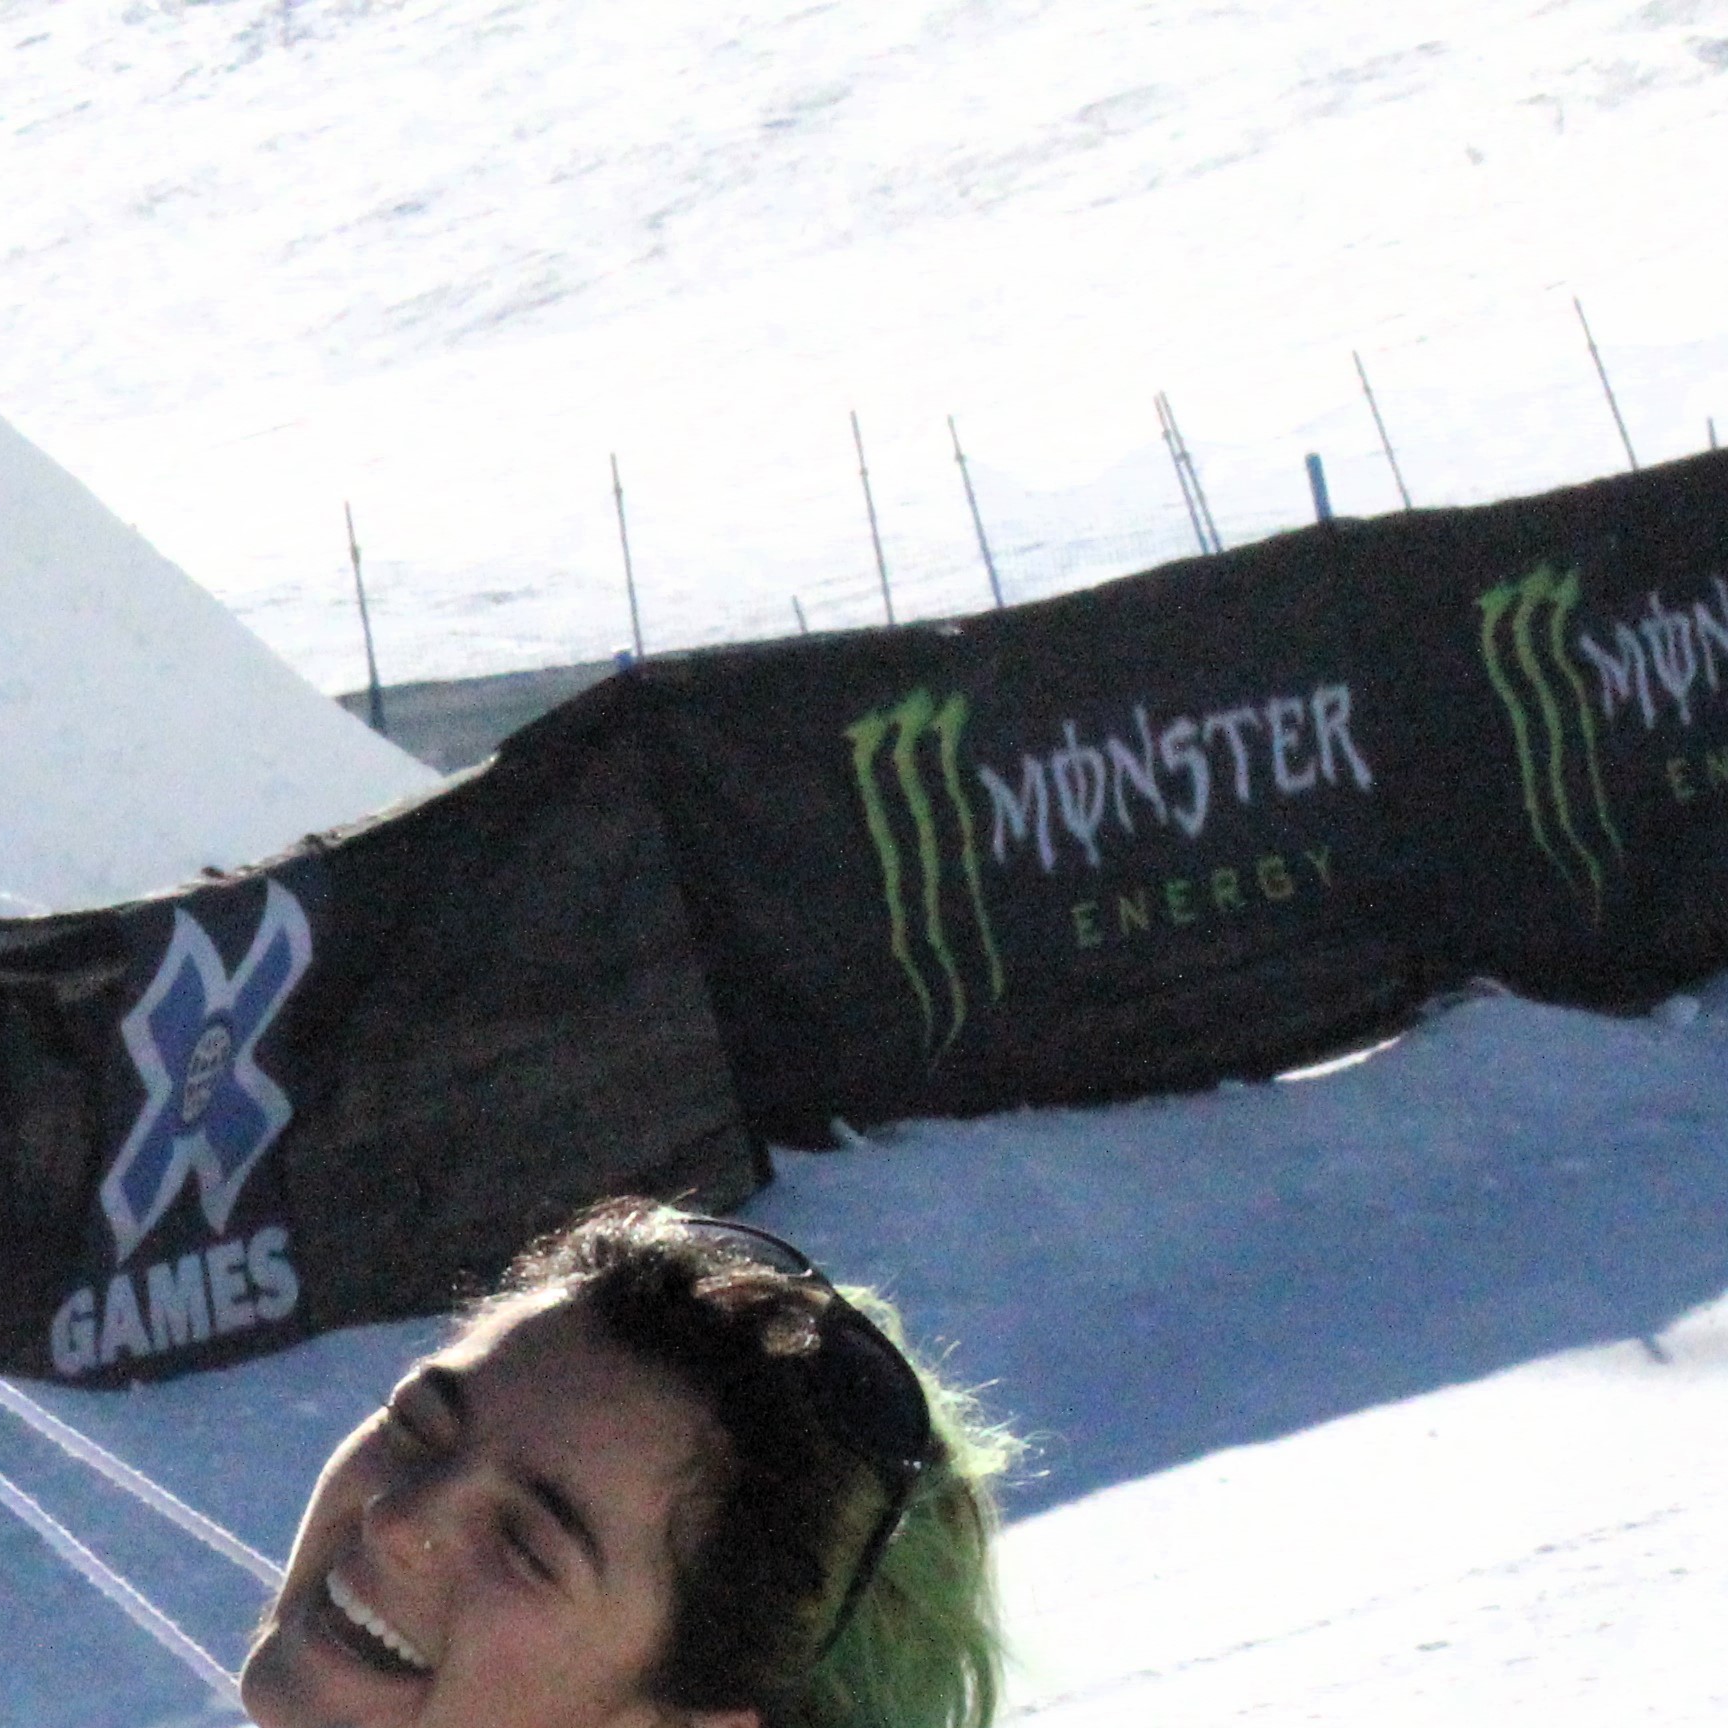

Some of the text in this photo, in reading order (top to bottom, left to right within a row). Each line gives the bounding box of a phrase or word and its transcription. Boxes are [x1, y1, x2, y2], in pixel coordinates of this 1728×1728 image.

[978, 682, 1373, 875] MONSTER
[1070, 843, 1335, 951] ENERGY
[49, 1224, 303, 1379] GAMES
